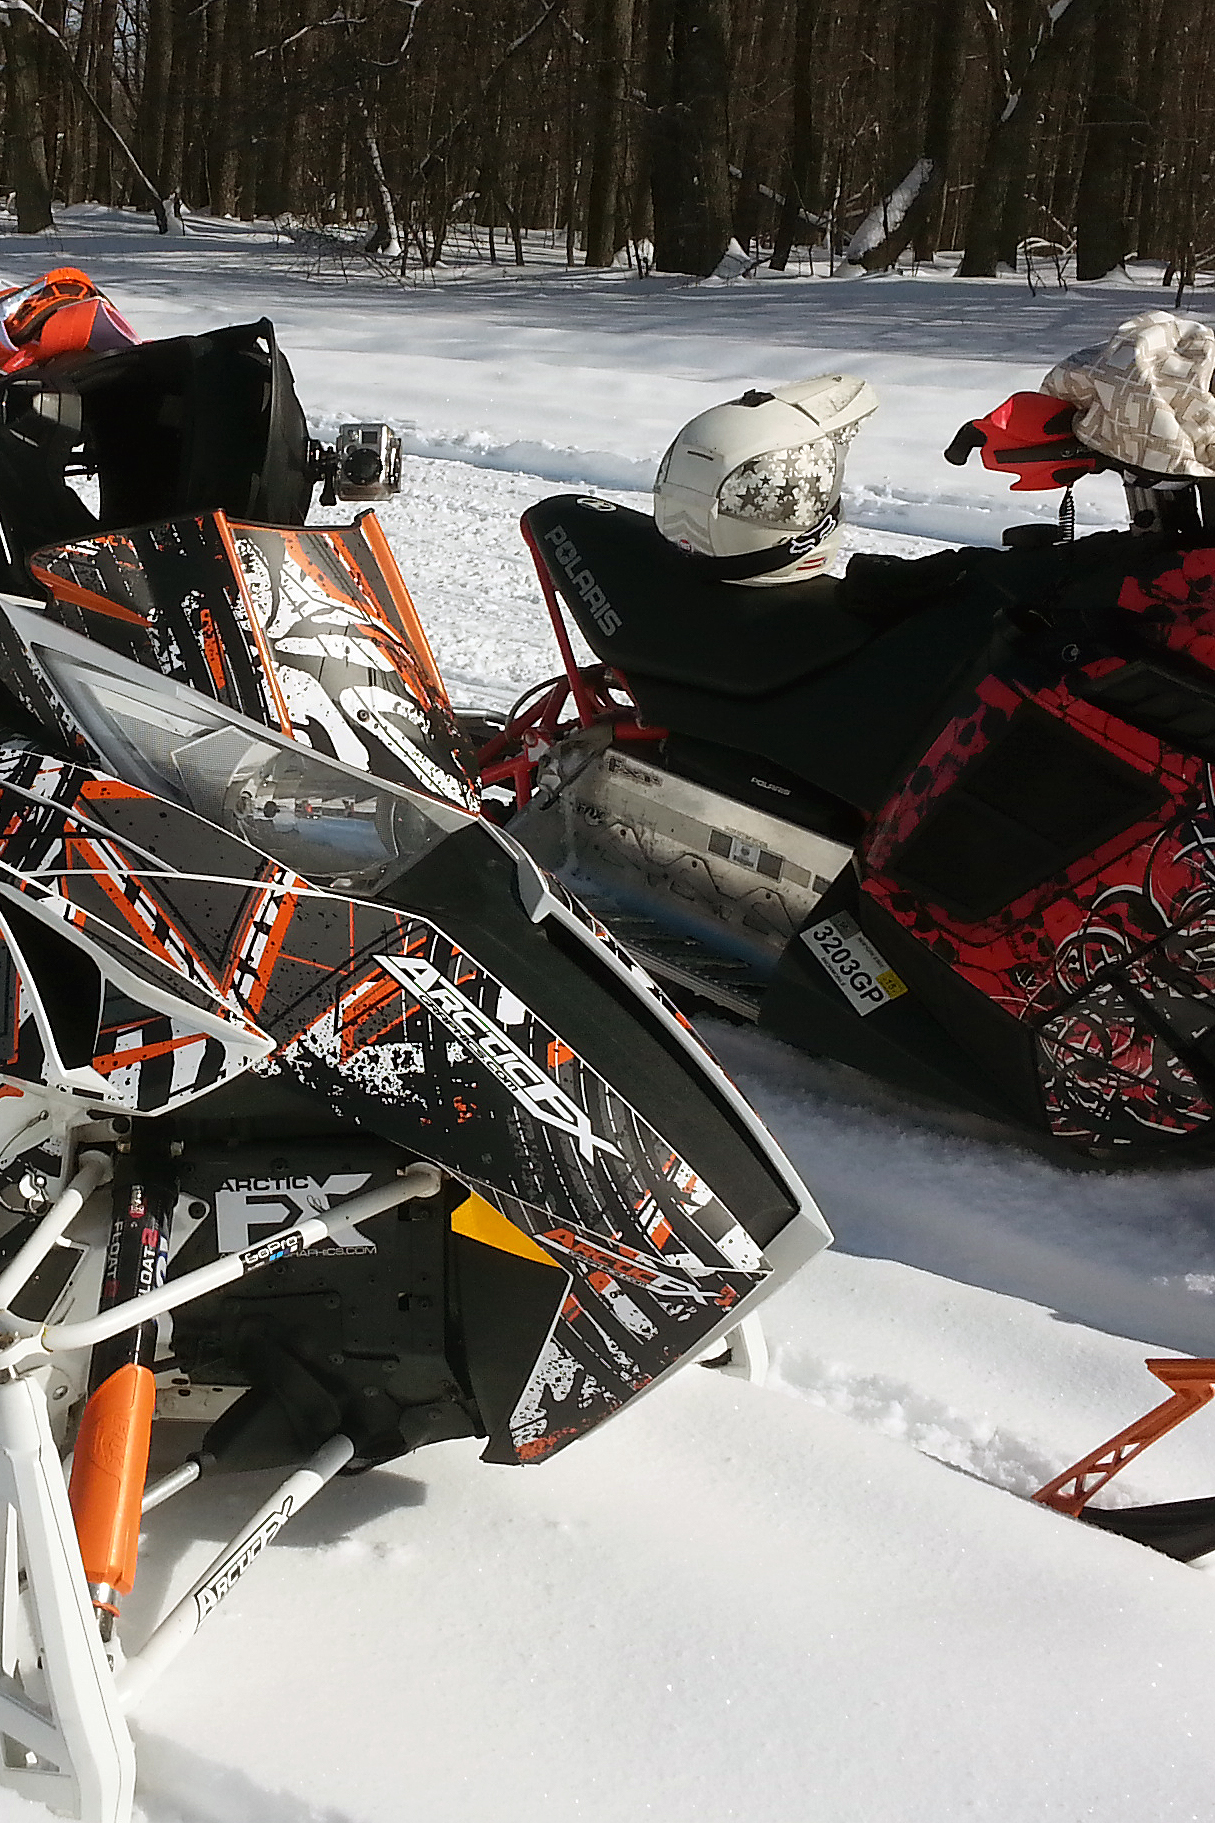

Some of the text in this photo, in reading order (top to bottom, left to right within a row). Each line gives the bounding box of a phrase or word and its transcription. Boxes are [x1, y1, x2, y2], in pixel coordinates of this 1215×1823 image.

[544, 525, 623, 637] POLARIS
[750, 776, 792, 796] POLARIS
[813, 925, 884, 1003] 3203GP
[215, 1173, 311, 1193] ARCTIC
